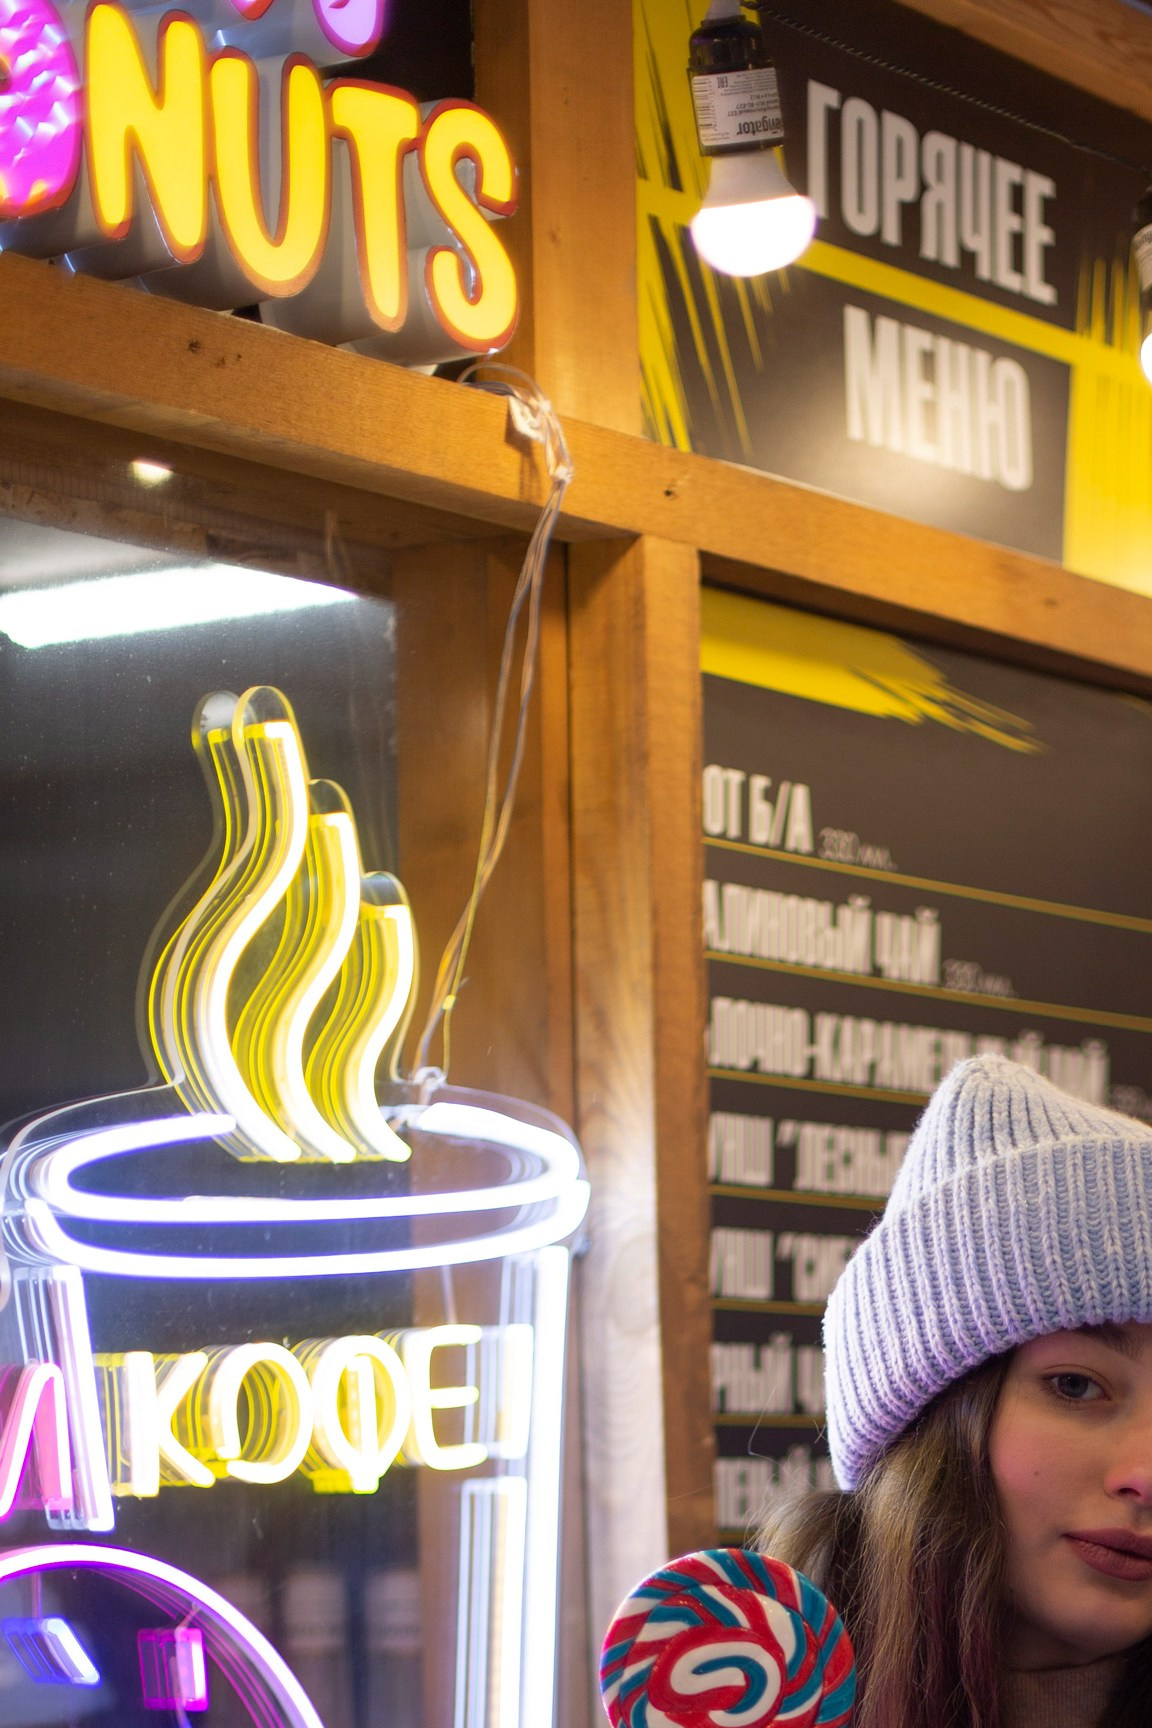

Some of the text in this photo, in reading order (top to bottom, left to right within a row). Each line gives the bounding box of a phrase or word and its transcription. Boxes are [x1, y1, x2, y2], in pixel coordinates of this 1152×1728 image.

[736, 115, 781, 136] avigator
[806, 78, 1058, 305] ГОРЯЧЕЕ
[843, 303, 1034, 492] МЕНЮ
[874, 904, 942, 985] ЧАЙ
[97, 1323, 488, 1497] КОФЕ
